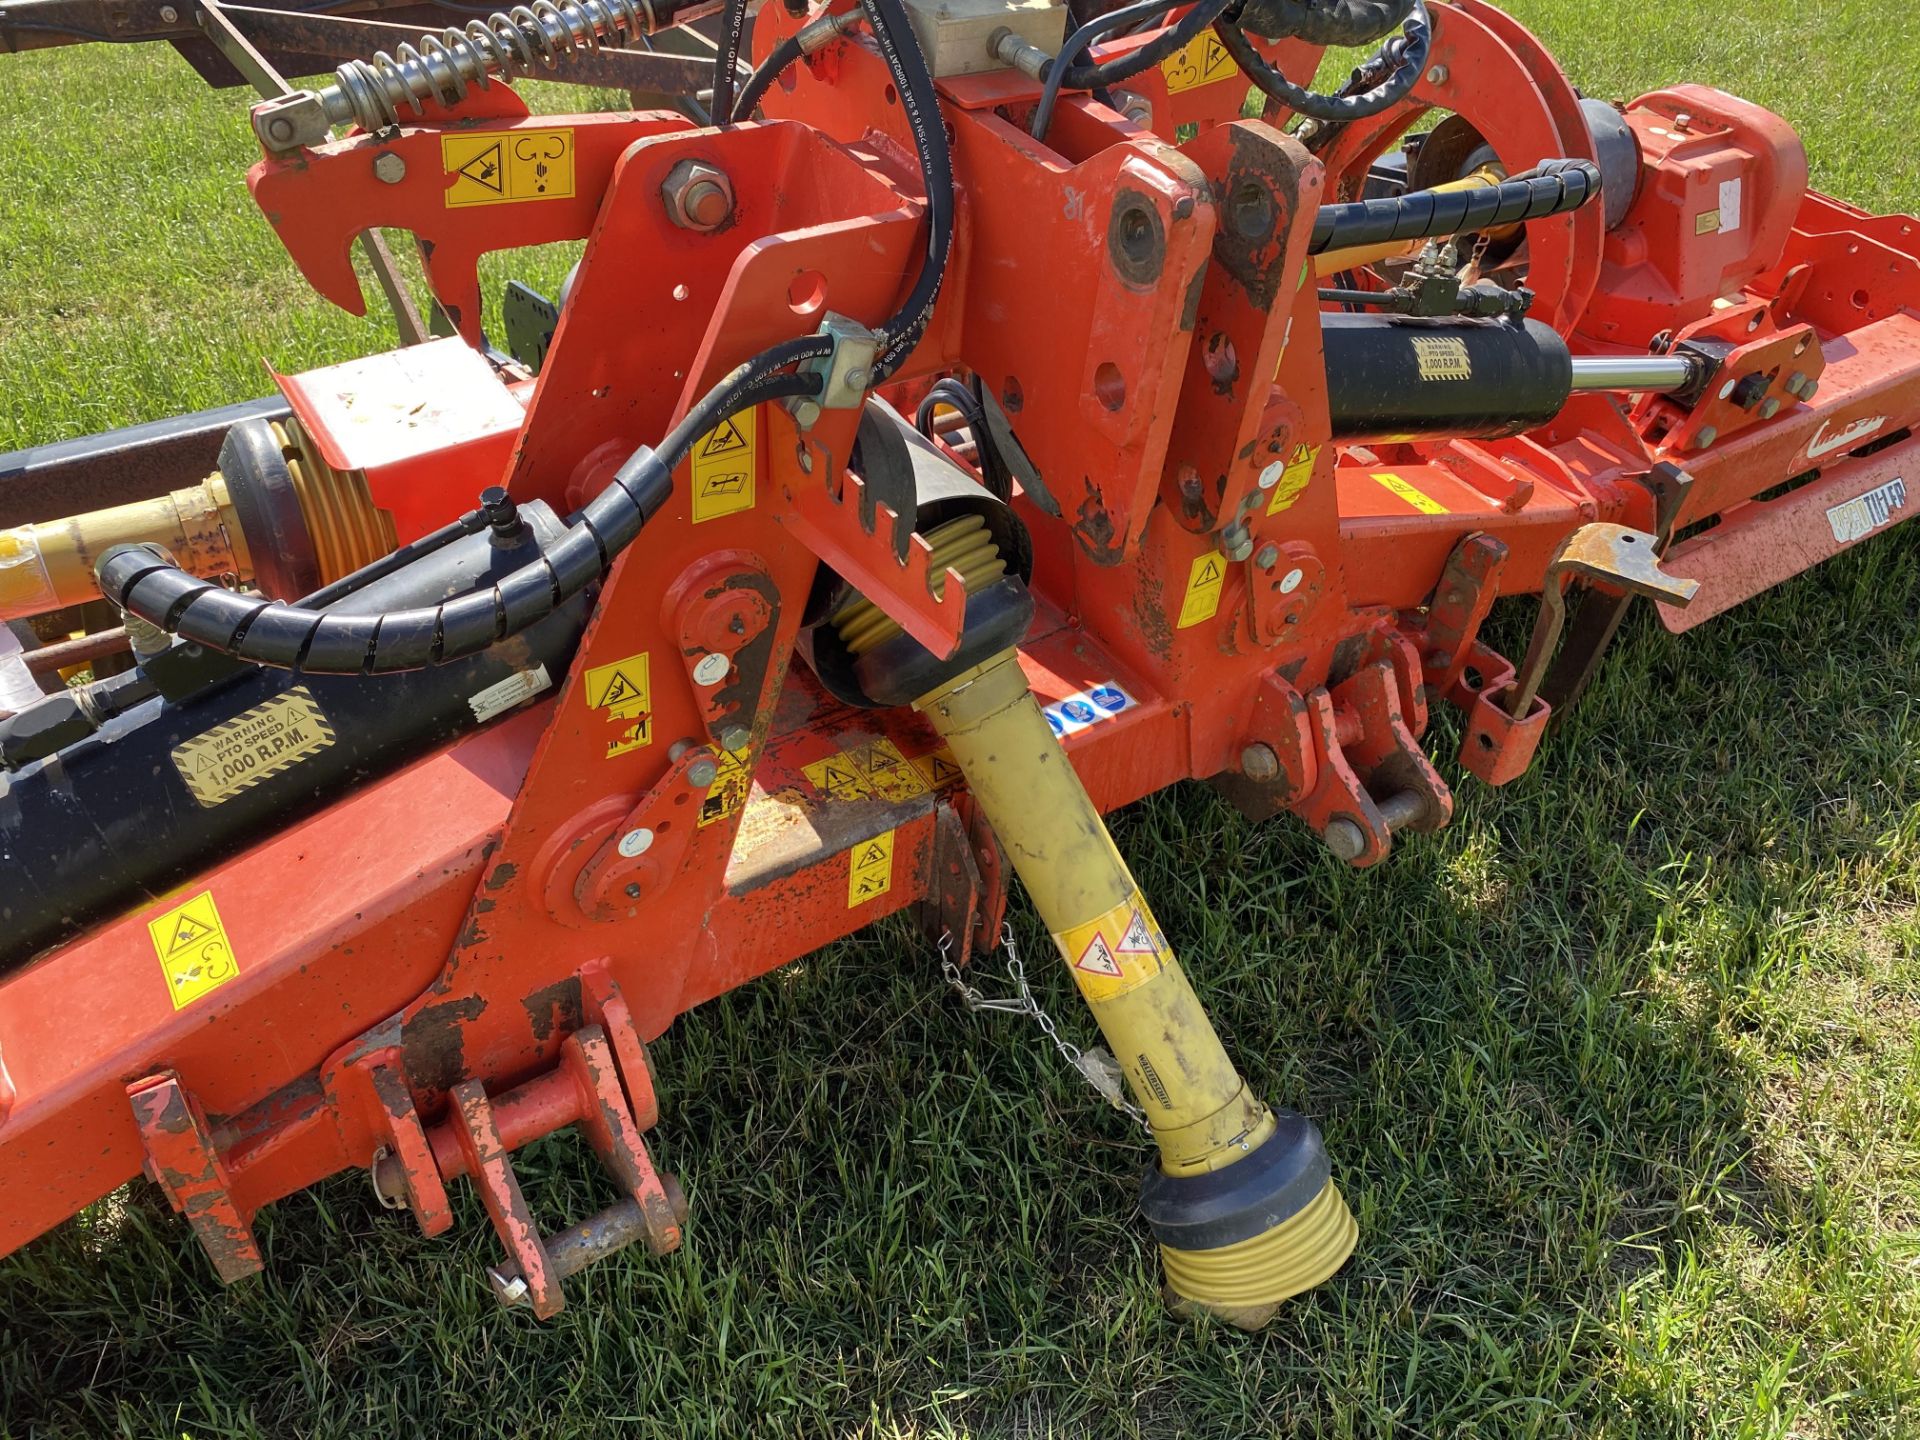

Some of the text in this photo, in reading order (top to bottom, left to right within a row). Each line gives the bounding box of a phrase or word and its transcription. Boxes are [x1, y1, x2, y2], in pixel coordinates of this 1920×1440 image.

[889, 54, 908, 89] 100R2AT
[904, 89, 916, 109] SAE
[917, 125, 927, 143] 2SN
[884, 351, 896, 363] 400
[212, 714, 276, 751] WARNING
[216, 722, 285, 762] PTO SPEED
[208, 755, 256, 787] 1,000
[256, 727, 309, 762] R.P.M.
